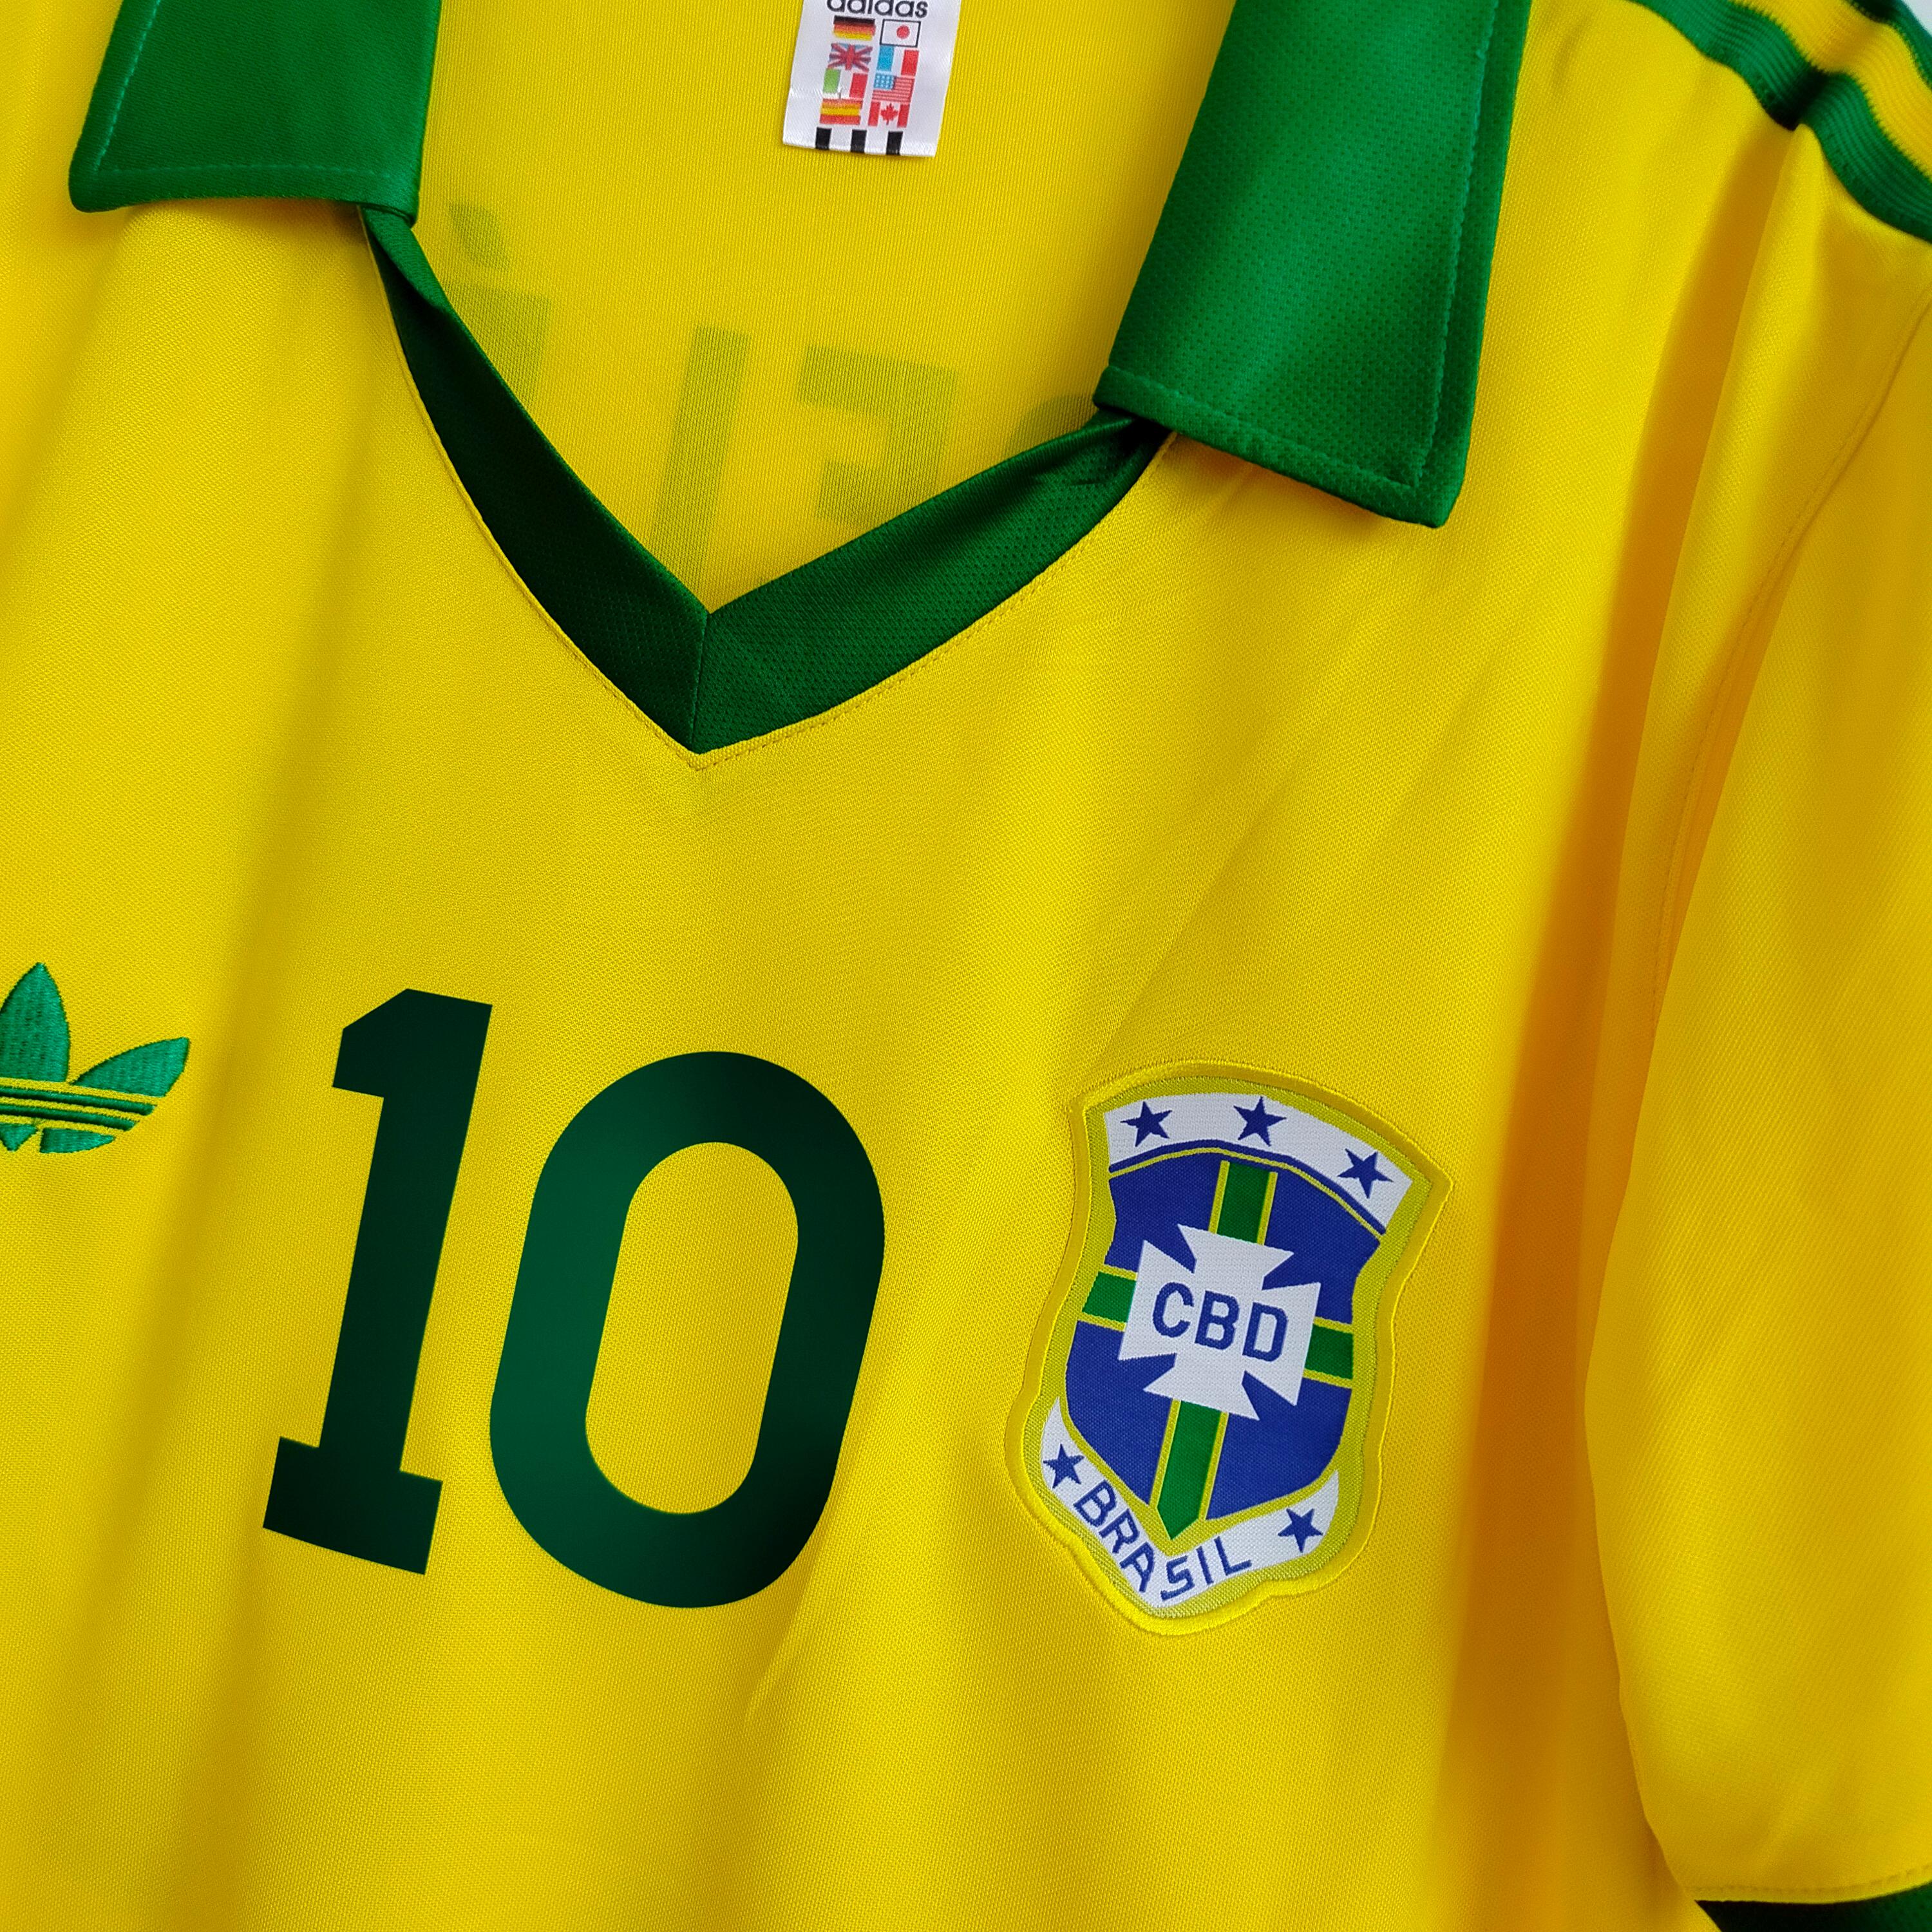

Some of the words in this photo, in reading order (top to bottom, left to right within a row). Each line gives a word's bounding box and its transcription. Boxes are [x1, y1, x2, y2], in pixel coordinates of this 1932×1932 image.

[263, 987, 886, 1609] 10
[1153, 1282, 1289, 1362] CBD
[1074, 1479, 1252, 1601] BRASIL
